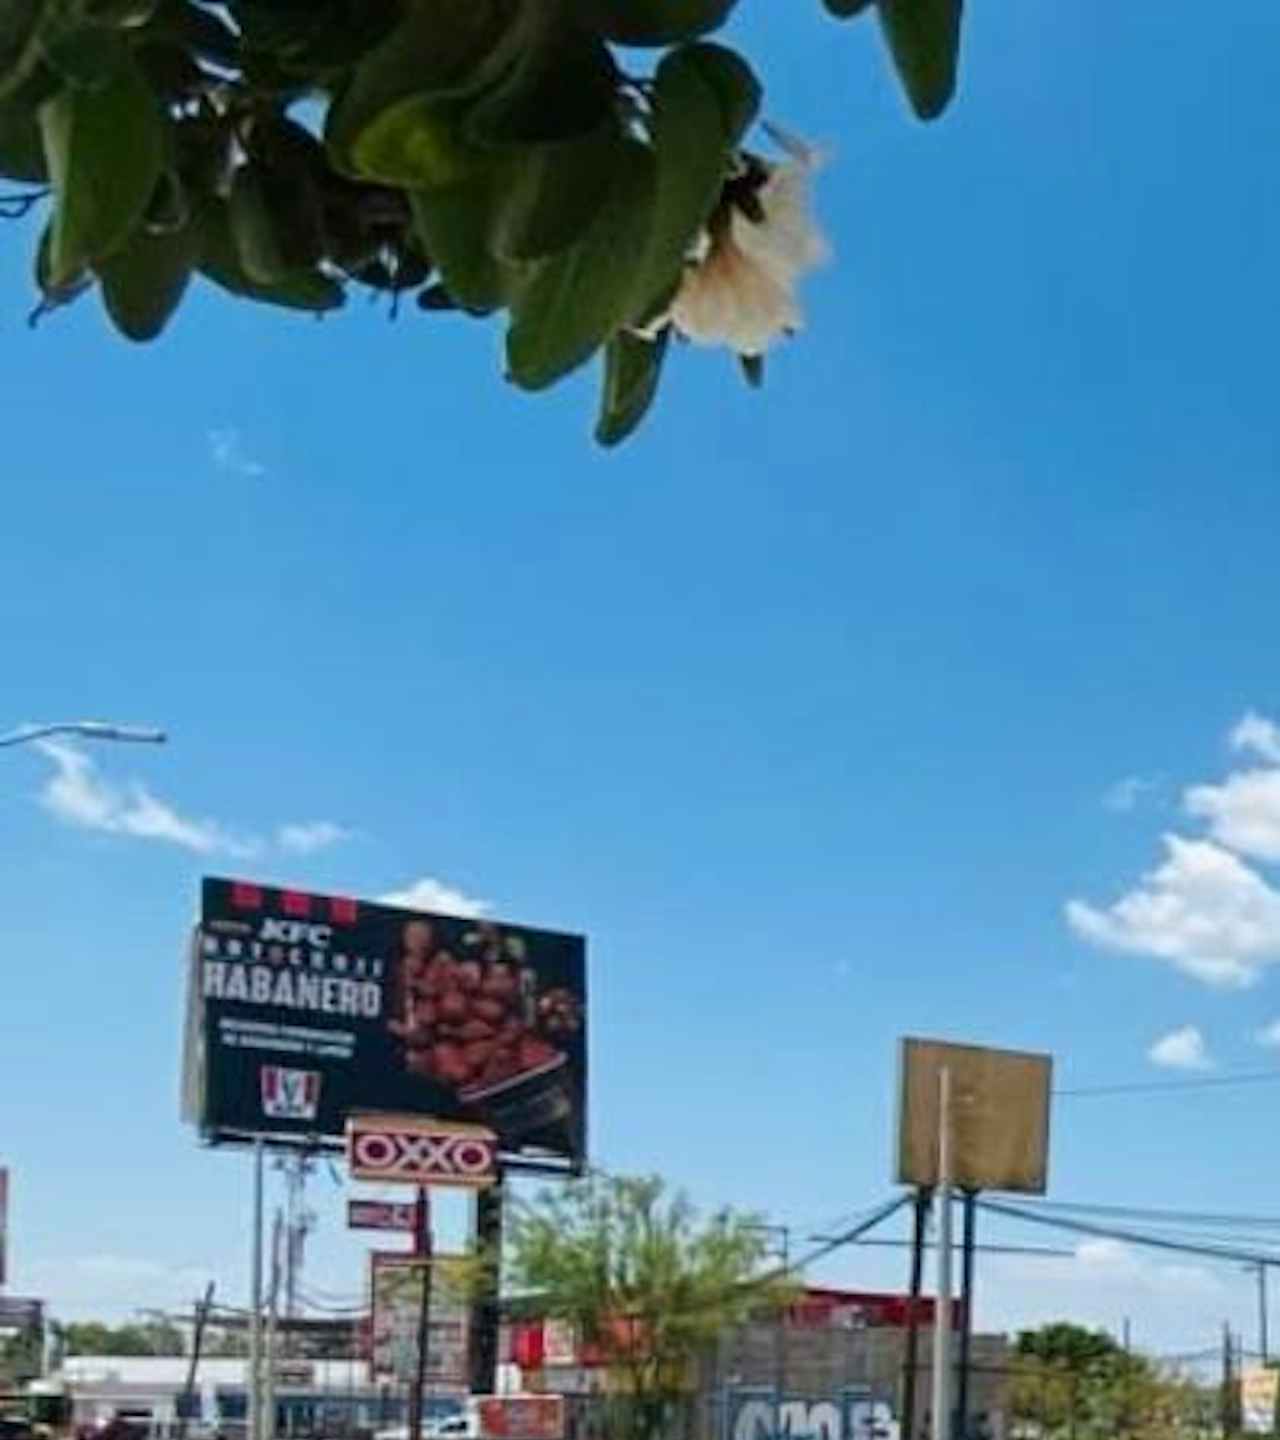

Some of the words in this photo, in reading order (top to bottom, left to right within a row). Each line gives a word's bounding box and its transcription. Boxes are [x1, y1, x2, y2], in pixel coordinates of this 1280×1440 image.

[258, 917, 333, 950] KFC
[202, 959, 384, 1018] HABANERO
[355, 1134, 491, 1174] OXXO
